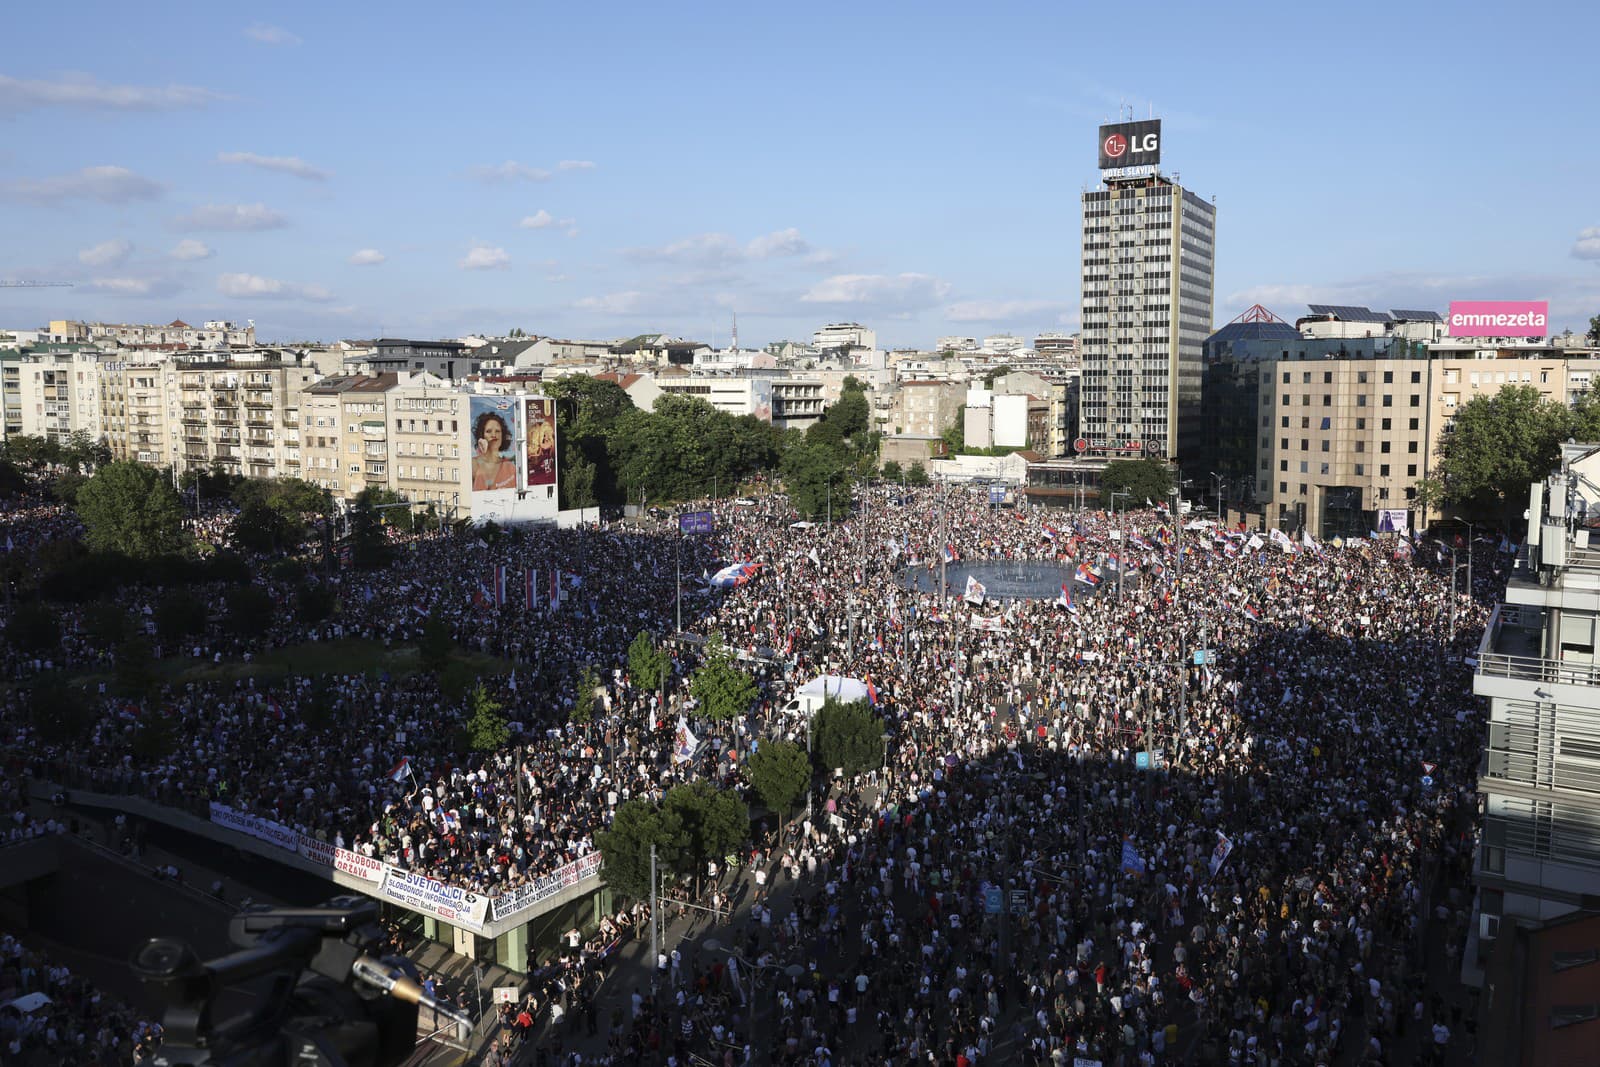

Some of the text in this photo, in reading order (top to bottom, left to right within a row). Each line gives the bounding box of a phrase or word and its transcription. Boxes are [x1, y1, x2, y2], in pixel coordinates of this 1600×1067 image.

[1131, 133, 1158, 153] LG
[1452, 311, 1545, 327] emmezeta
[388, 879, 424, 897] SLOBODNOG
